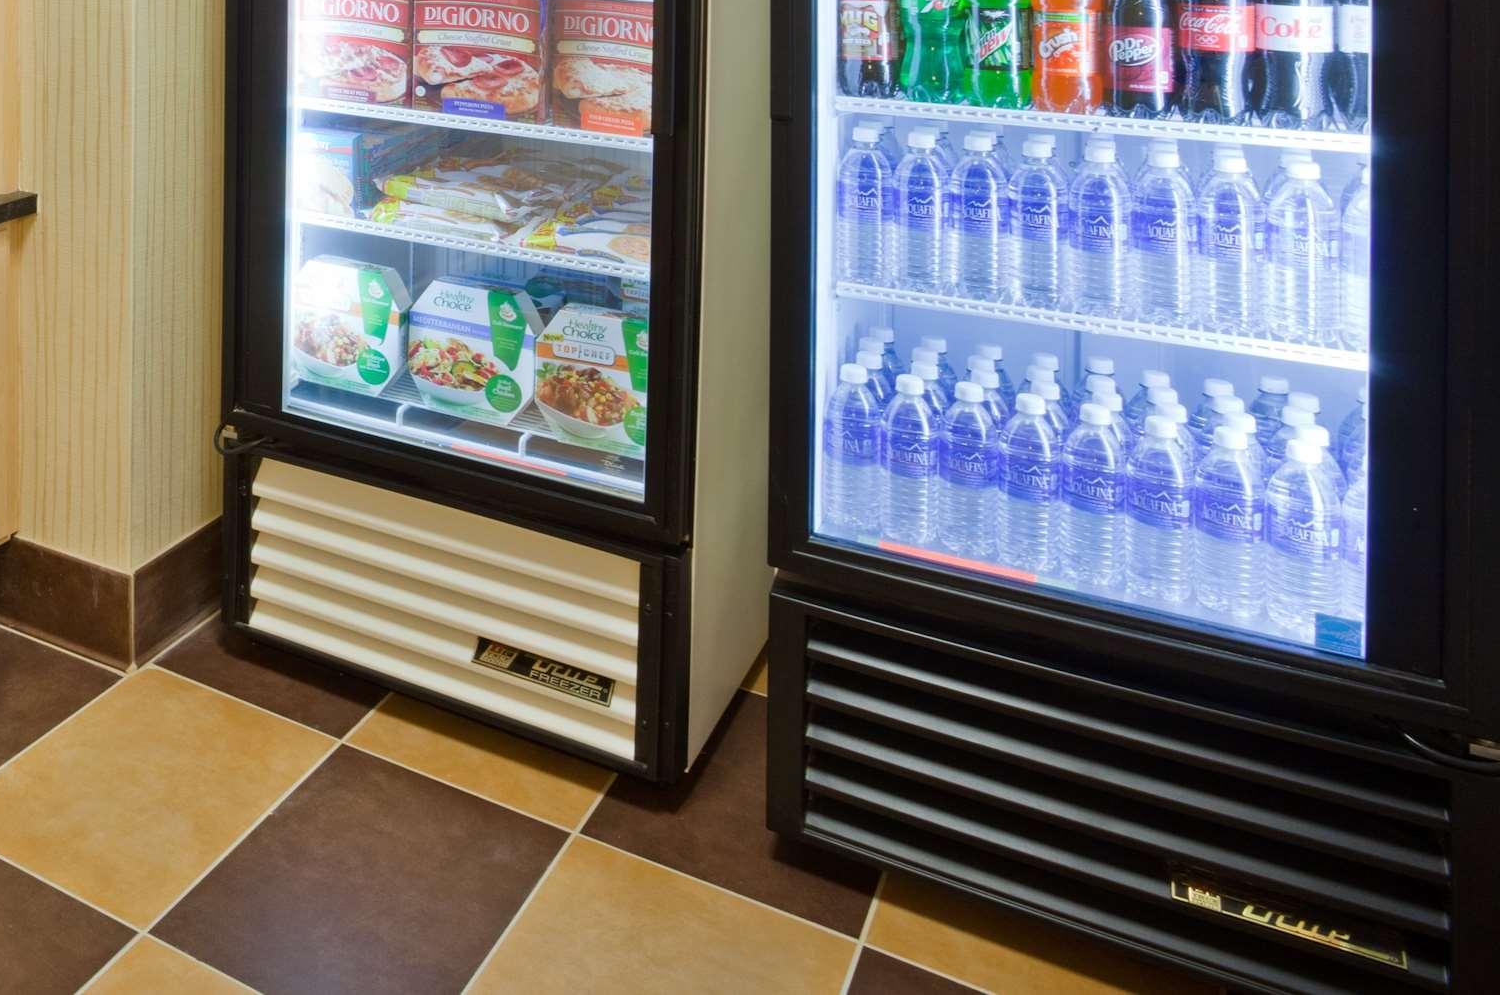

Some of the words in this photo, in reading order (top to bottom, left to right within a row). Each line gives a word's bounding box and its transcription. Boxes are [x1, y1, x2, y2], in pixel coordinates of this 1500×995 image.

[424, 6, 530, 33] DIGIORNO
[563, 15, 653, 43] DIGIORN
[1039, 28, 1078, 59] Crush
[1112, 40, 1156, 62] Pepper
[1124, 37, 1144, 50] Dr
[433, 295, 473, 312] Choice
[562, 325, 605, 341] Choice
[530, 669, 602, 700] FREEZER
